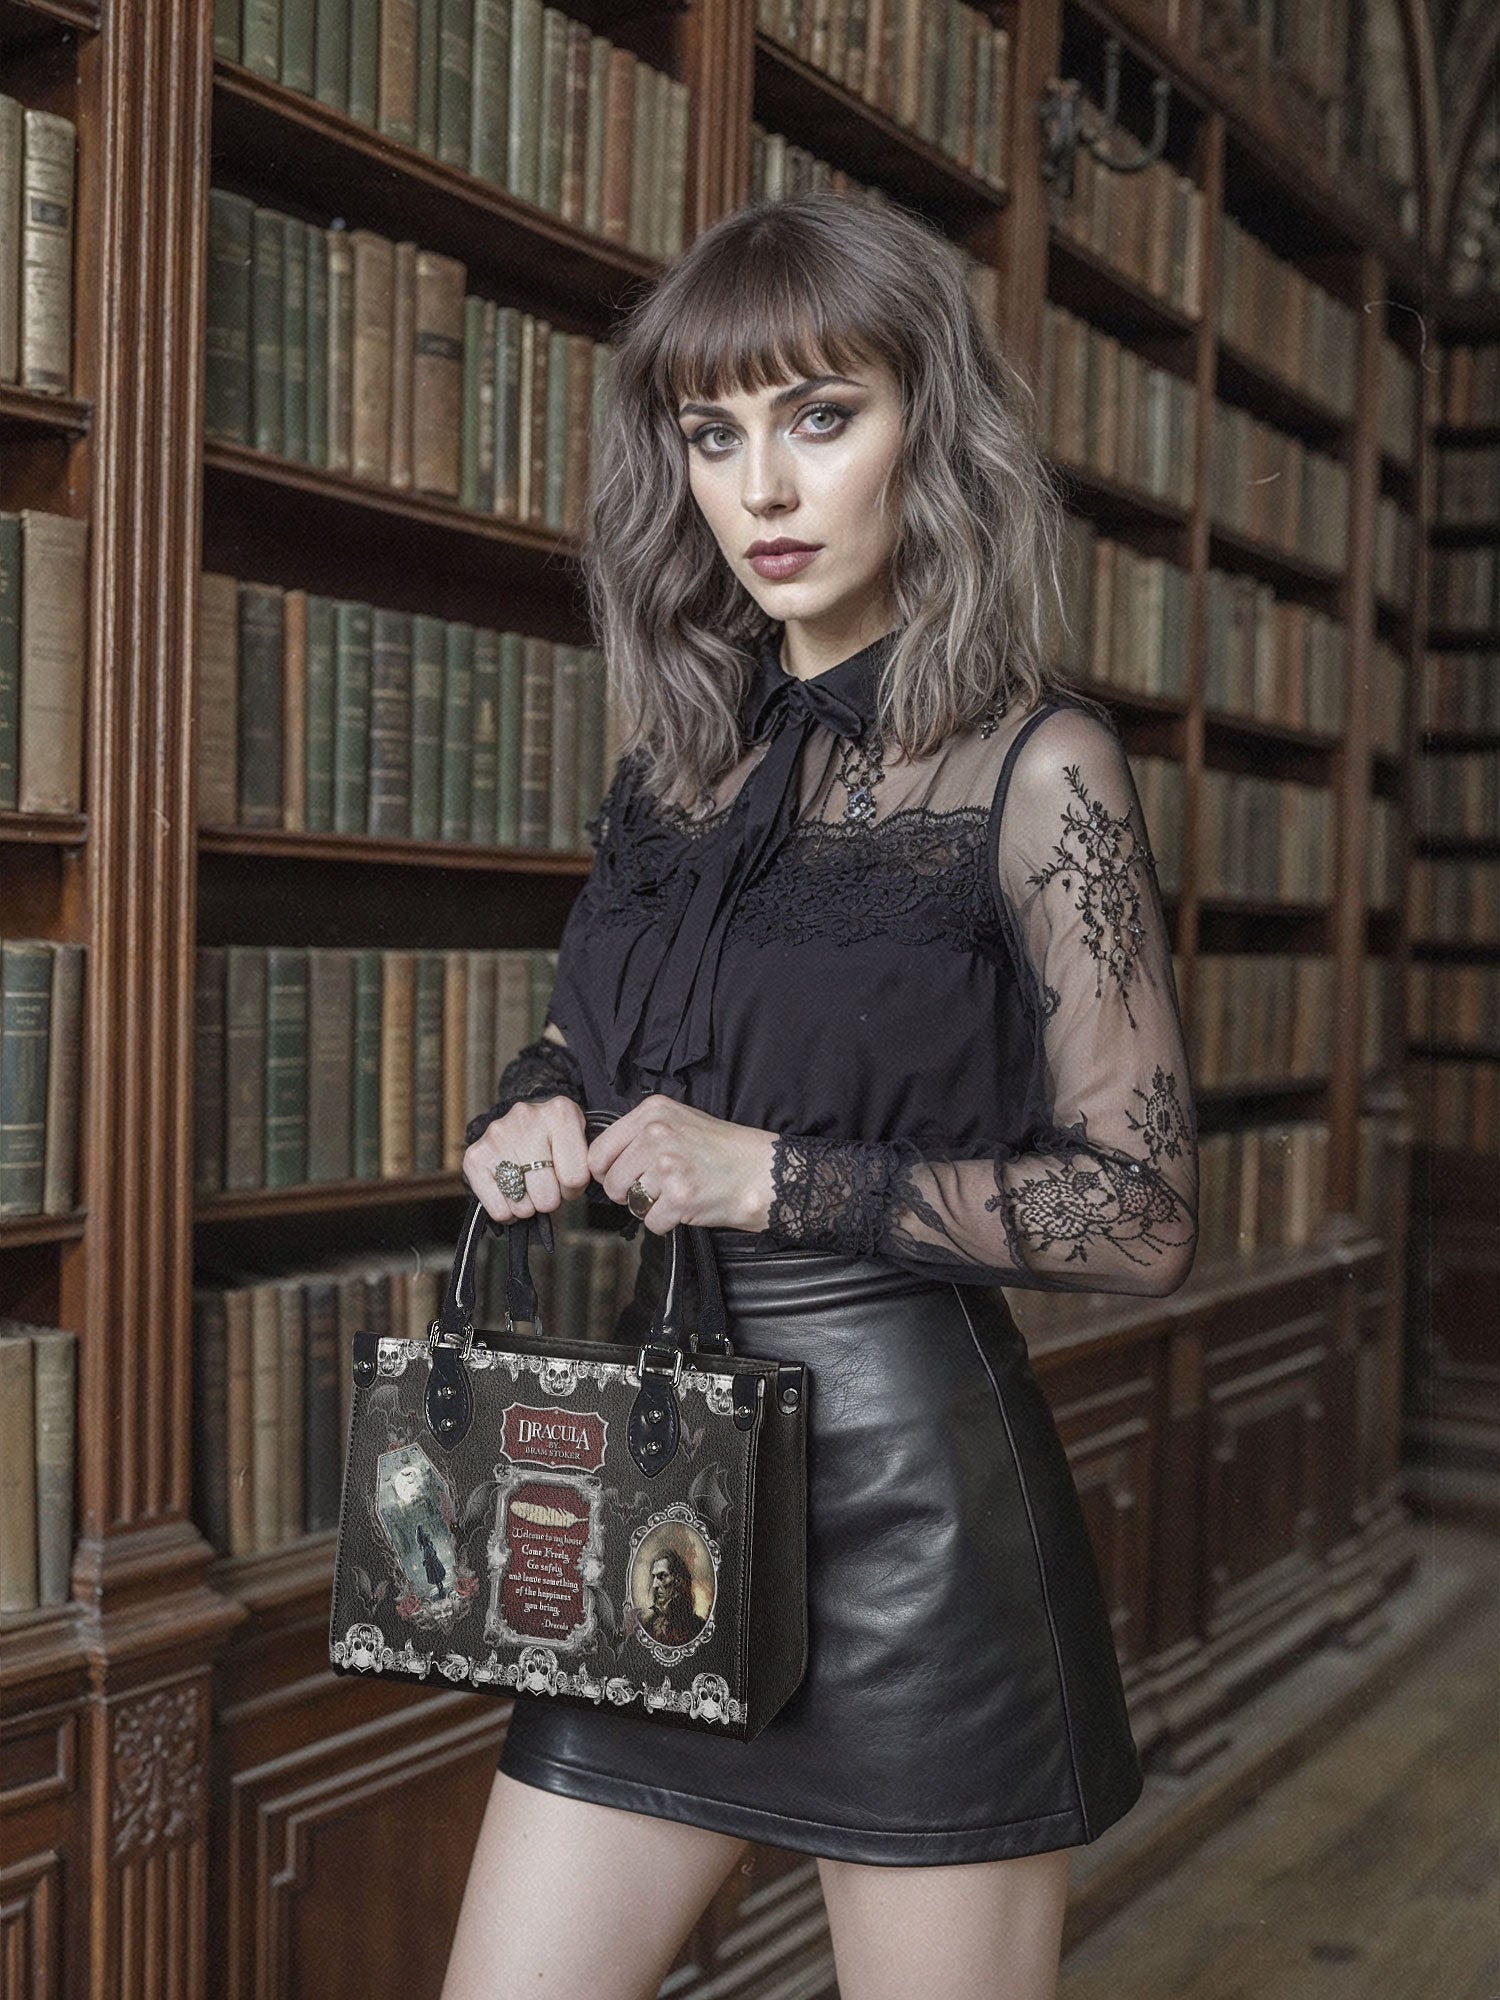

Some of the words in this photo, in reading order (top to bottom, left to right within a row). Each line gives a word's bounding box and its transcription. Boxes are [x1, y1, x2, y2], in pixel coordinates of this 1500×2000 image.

[518, 1419, 590, 1451] DRACULA
[525, 1447, 548, 1456] BRAM
[549, 1448, 581, 1460] STOKER
[512, 1527, 544, 1540] Welcome
[545, 1531, 553, 1541] to
[553, 1535, 565, 1547] my
[521, 1543, 543, 1556] Come
[543, 1546, 570, 1564] Freely
[526, 1559, 540, 1570] Go
[540, 1563, 563, 1577] safely
[508, 1572, 521, 1581] and
[522, 1572, 541, 1583] leave
[542, 1577, 579, 1593] something
[515, 1586, 524, 1597] of
[524, 1586, 537, 1597] the
[537, 1587, 571, 1601] happiness
[523, 1602, 538, 1613] you
